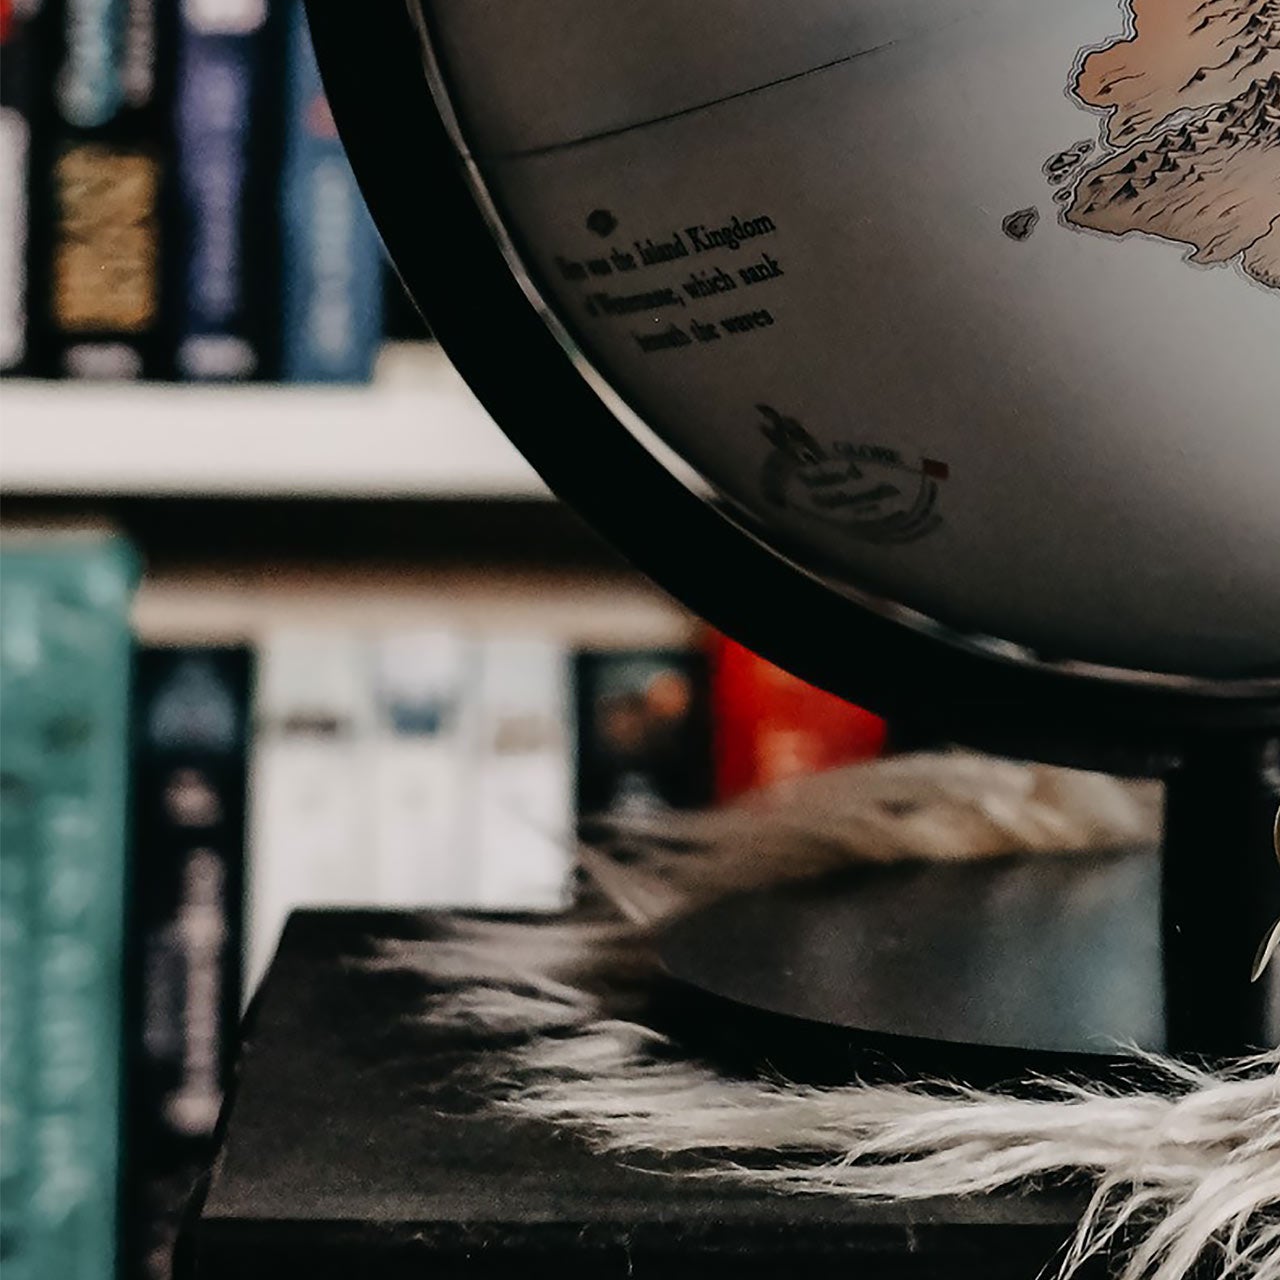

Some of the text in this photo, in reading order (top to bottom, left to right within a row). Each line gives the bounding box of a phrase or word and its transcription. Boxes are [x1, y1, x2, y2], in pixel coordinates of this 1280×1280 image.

[684, 215, 777, 250] Kingdom
[682, 252, 784, 299] which sank
[720, 308, 775, 334] waves
